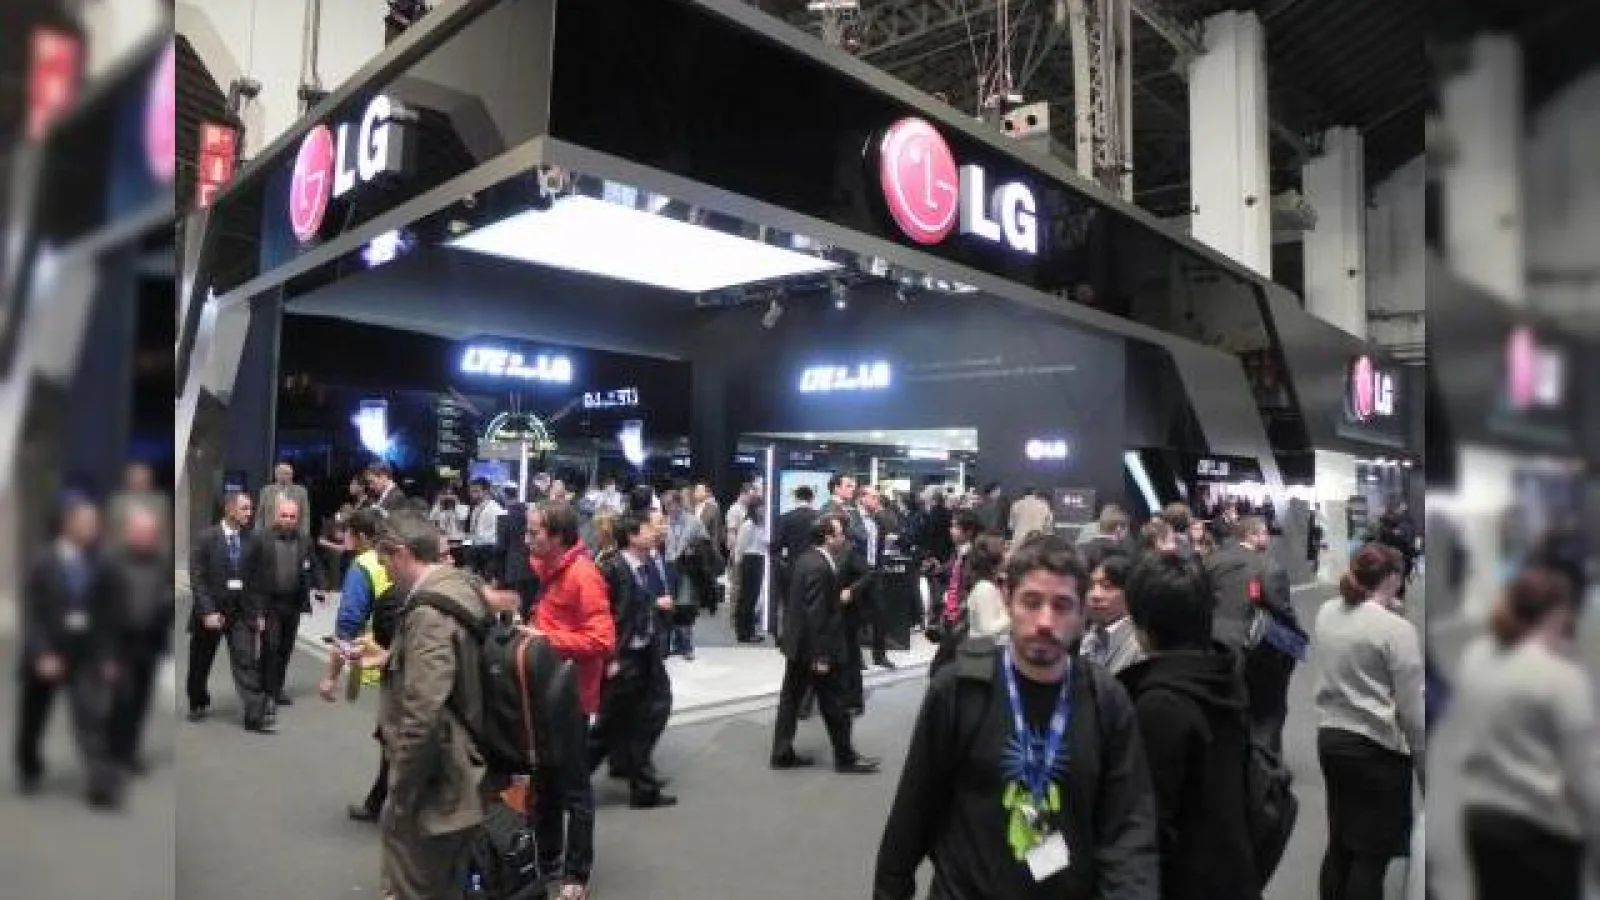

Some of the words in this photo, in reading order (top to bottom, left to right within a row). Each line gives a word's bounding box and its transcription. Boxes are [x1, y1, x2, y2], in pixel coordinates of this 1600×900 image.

[332, 93, 392, 198] LG
[959, 164, 1038, 254] LG
[1374, 371, 1394, 416] LG
